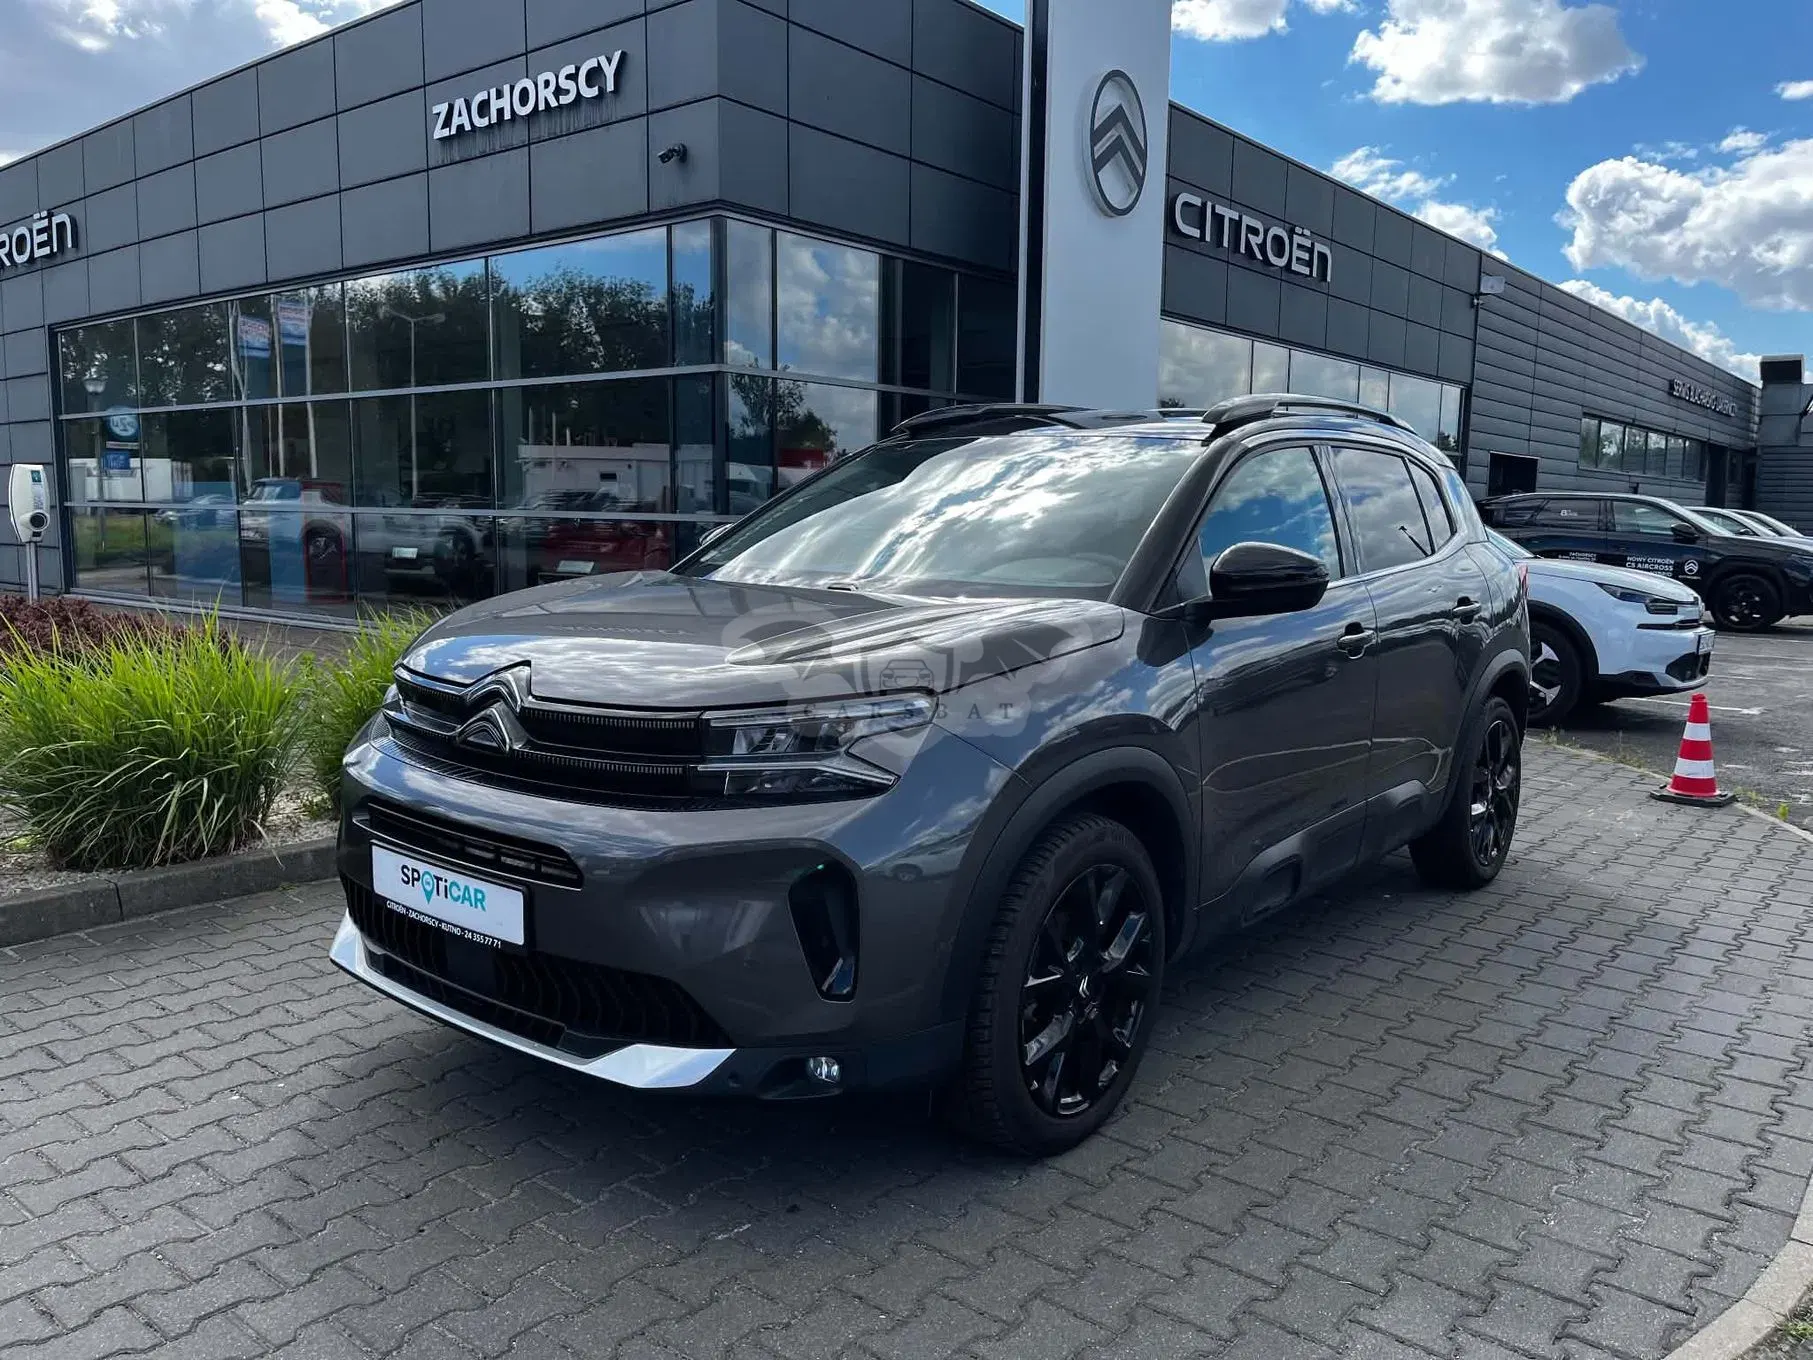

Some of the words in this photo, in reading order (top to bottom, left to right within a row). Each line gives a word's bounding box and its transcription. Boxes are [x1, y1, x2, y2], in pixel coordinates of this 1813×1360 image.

[432, 50, 622, 140] ZACHORSCY
[1637, 562, 1674, 571] AIRCROSS
[409, 909, 439, 928] ZACHORSCY
[464, 930, 472, 940] 24
[472, 933, 485, 943] 355
[493, 939, 501, 949] 71
